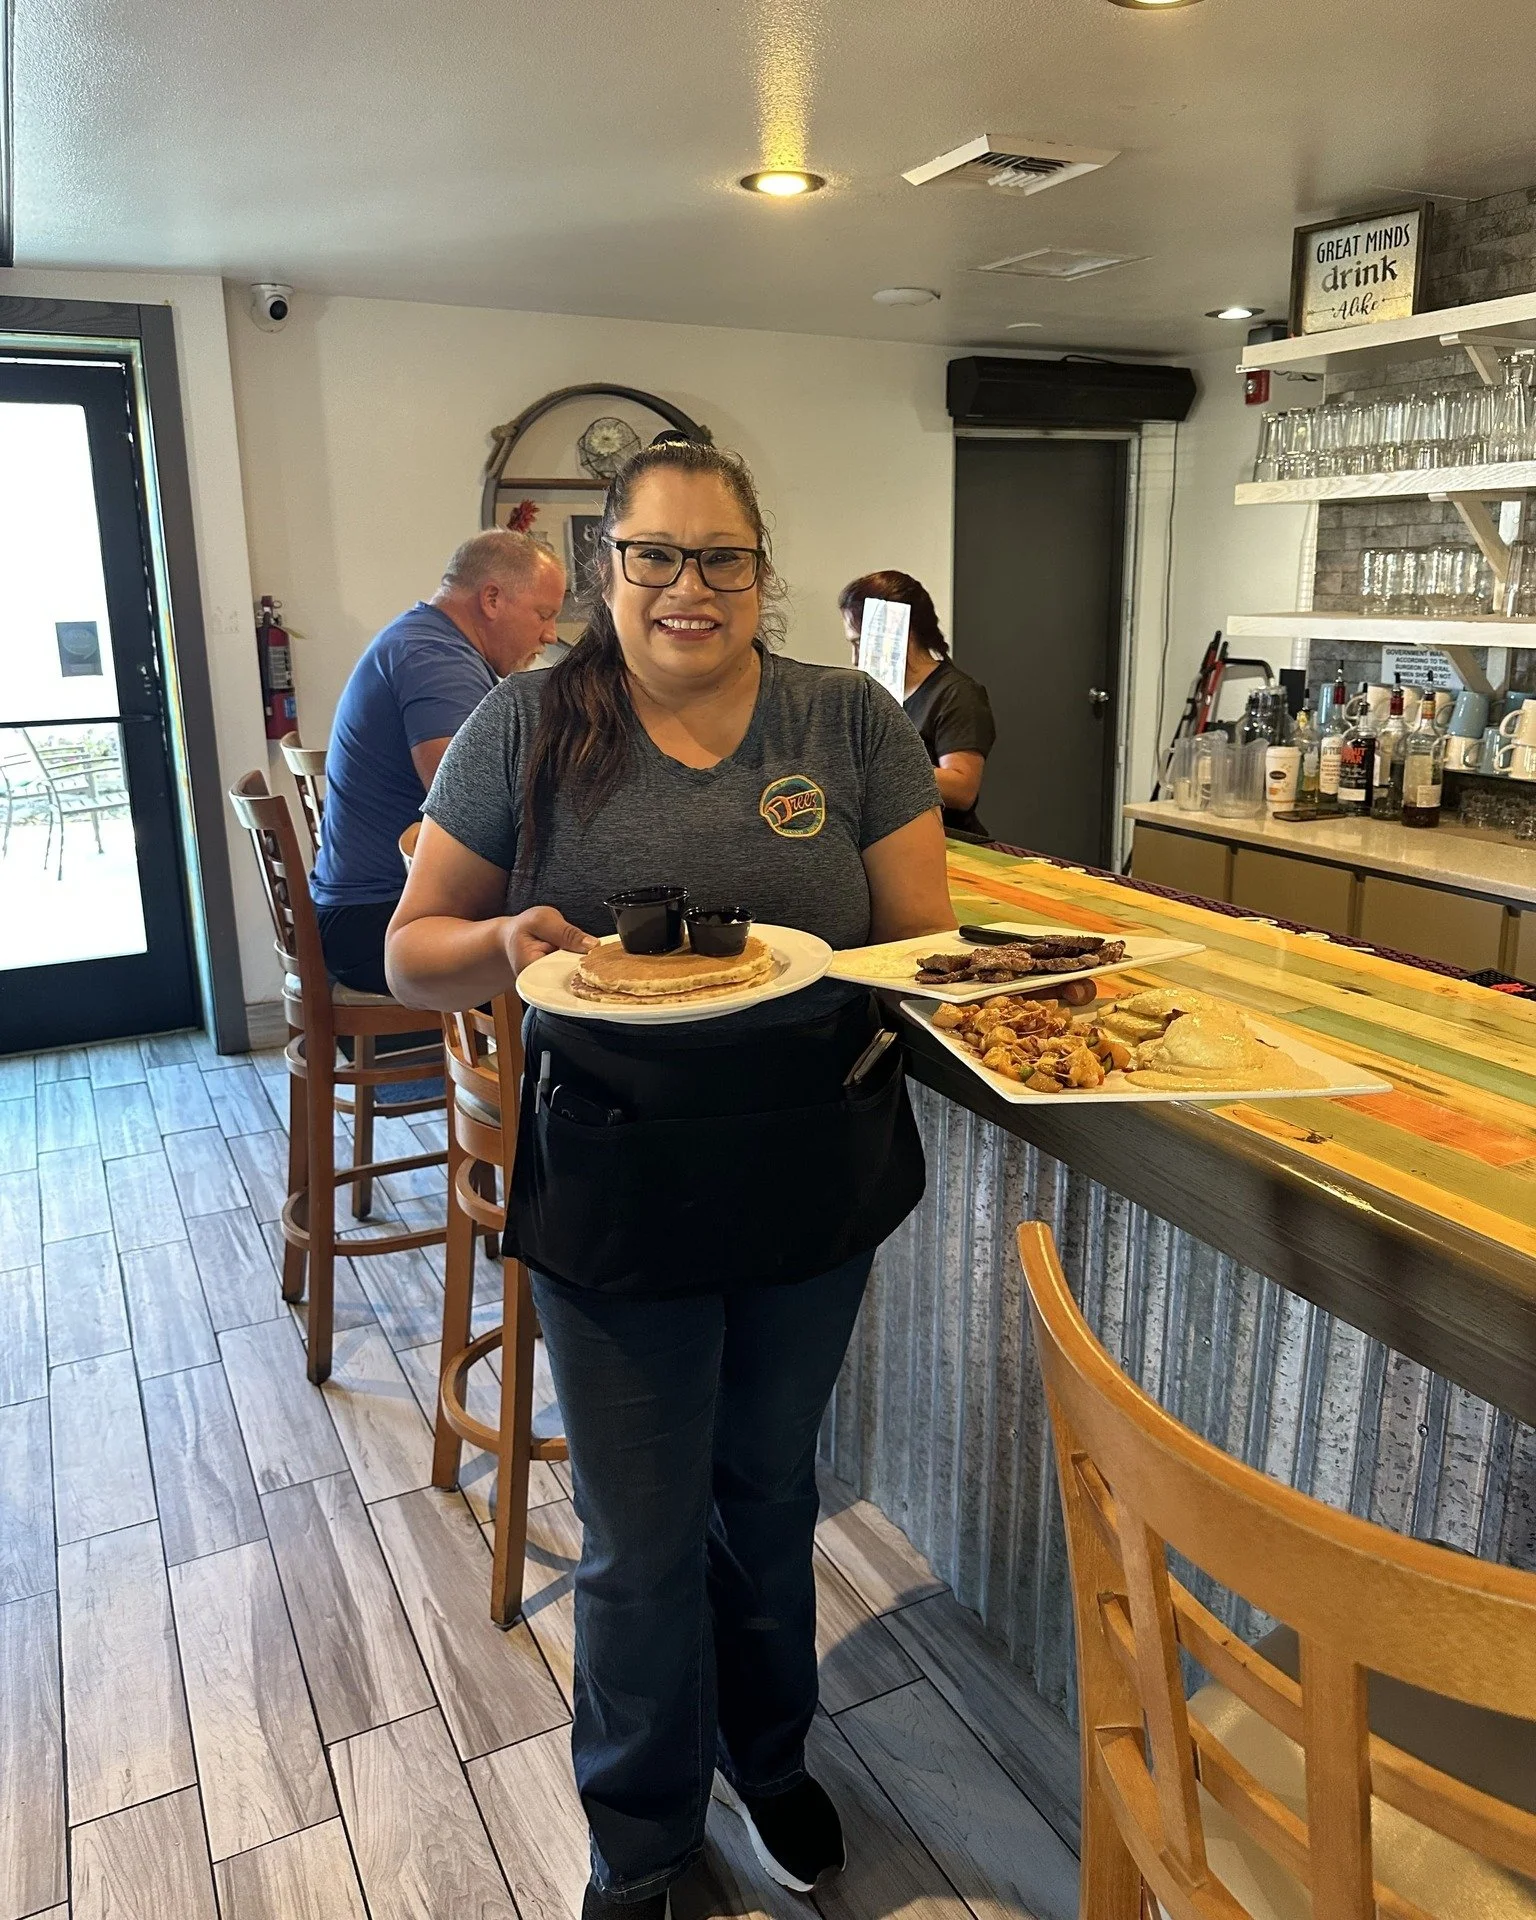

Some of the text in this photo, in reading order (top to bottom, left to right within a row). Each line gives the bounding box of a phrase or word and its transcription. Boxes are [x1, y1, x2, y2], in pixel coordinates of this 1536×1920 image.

[1317, 223, 1410, 263] GREAT MINDS
[1321, 254, 1398, 293] drink
[1333, 292, 1379, 319] Alike
